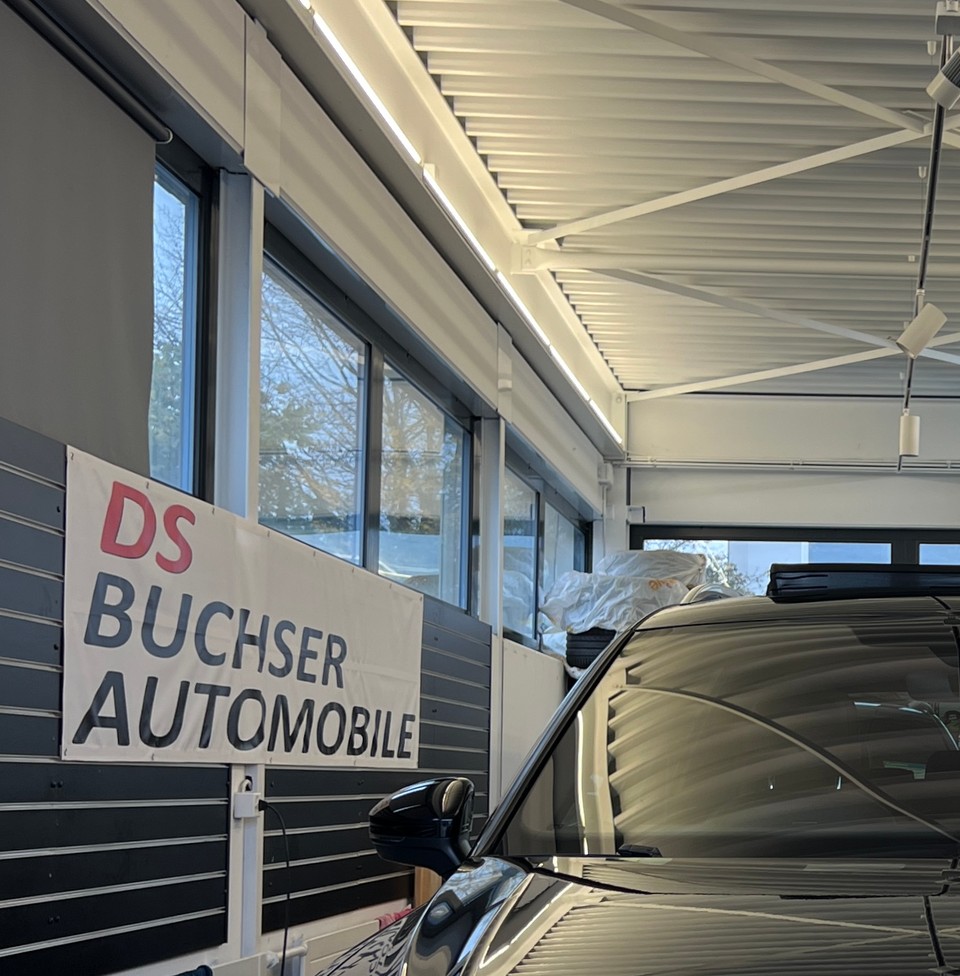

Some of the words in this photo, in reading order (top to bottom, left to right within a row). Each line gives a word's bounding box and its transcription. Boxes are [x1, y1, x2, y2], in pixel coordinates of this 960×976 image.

[100, 480, 196, 574] DS
[83, 571, 348, 689] BUCHSER
[72, 670, 416, 760] AUTOMOBILE
